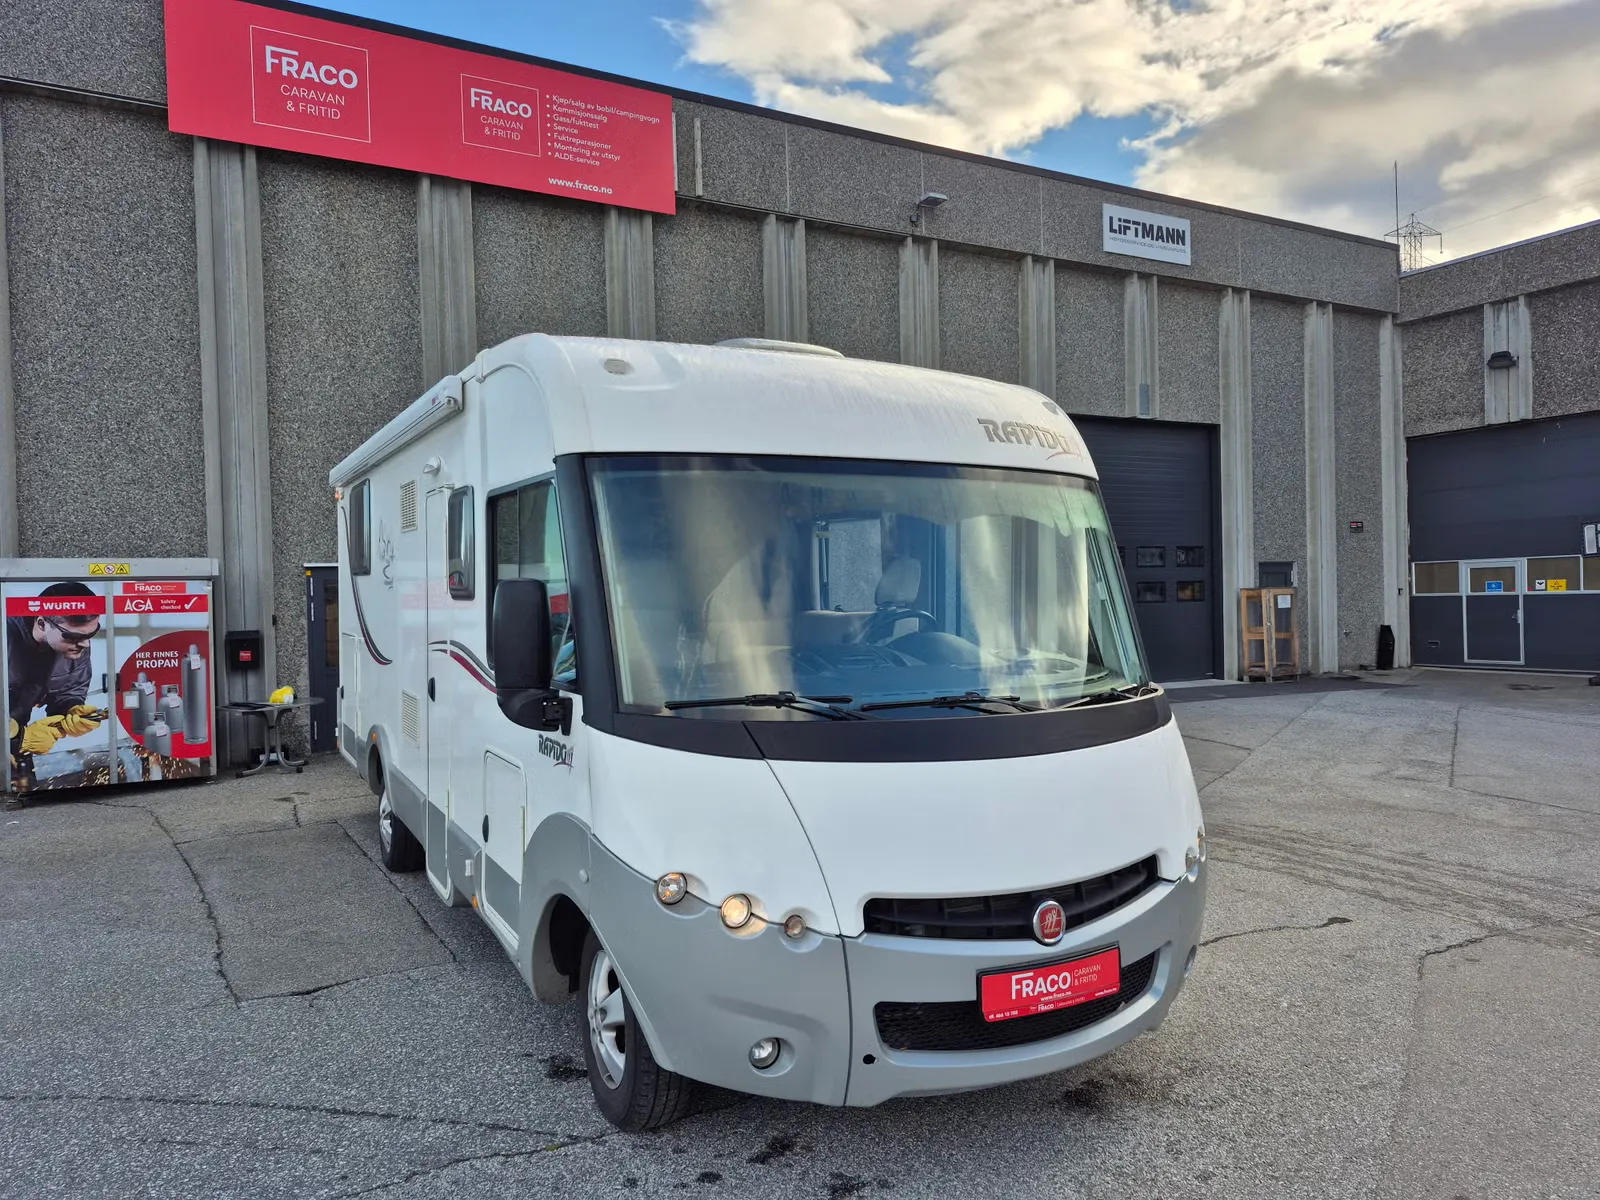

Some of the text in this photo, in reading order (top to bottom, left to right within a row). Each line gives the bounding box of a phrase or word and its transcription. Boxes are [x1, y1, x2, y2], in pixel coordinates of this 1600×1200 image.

[265, 45, 358, 89] FRACO
[280, 84, 345, 106] CARAVAN
[286, 101, 341, 120] & FRITID
[470, 87, 532, 119] FRACO
[552, 95, 586, 110] Kjøp/salg
[596, 104, 660, 124] bobil/campingvogn
[552, 104, 608, 123] Kommisjonssalg
[480, 115, 524, 131] CARAVAN
[553, 113, 600, 130] Gass/fukttest
[553, 122, 579, 135] Service
[484, 127, 521, 141] & FRITID
[553, 132, 612, 150] Fuktreparasjoner
[554, 142, 590, 156] Montering
[601, 151, 621, 162] utstyr
[554, 152, 601, 167] ALDE-service
[548, 177, 613, 195] www.fraco.no
[134, 583, 162, 592] FRACO
[42, 601, 86, 611] WÜRTH
[124, 597, 154, 612] AGA
[153, 650, 179, 658] FINNES
[136, 659, 179, 669] PROPAN
[1074, 964, 1101, 977] CARAVAN
[1011, 972, 1071, 1000] FRACO
[1074, 973, 1098, 986] & FRITID
[1040, 990, 1072, 1002] www.fraco.no
[1038, 1003, 1055, 1012] FRACO
